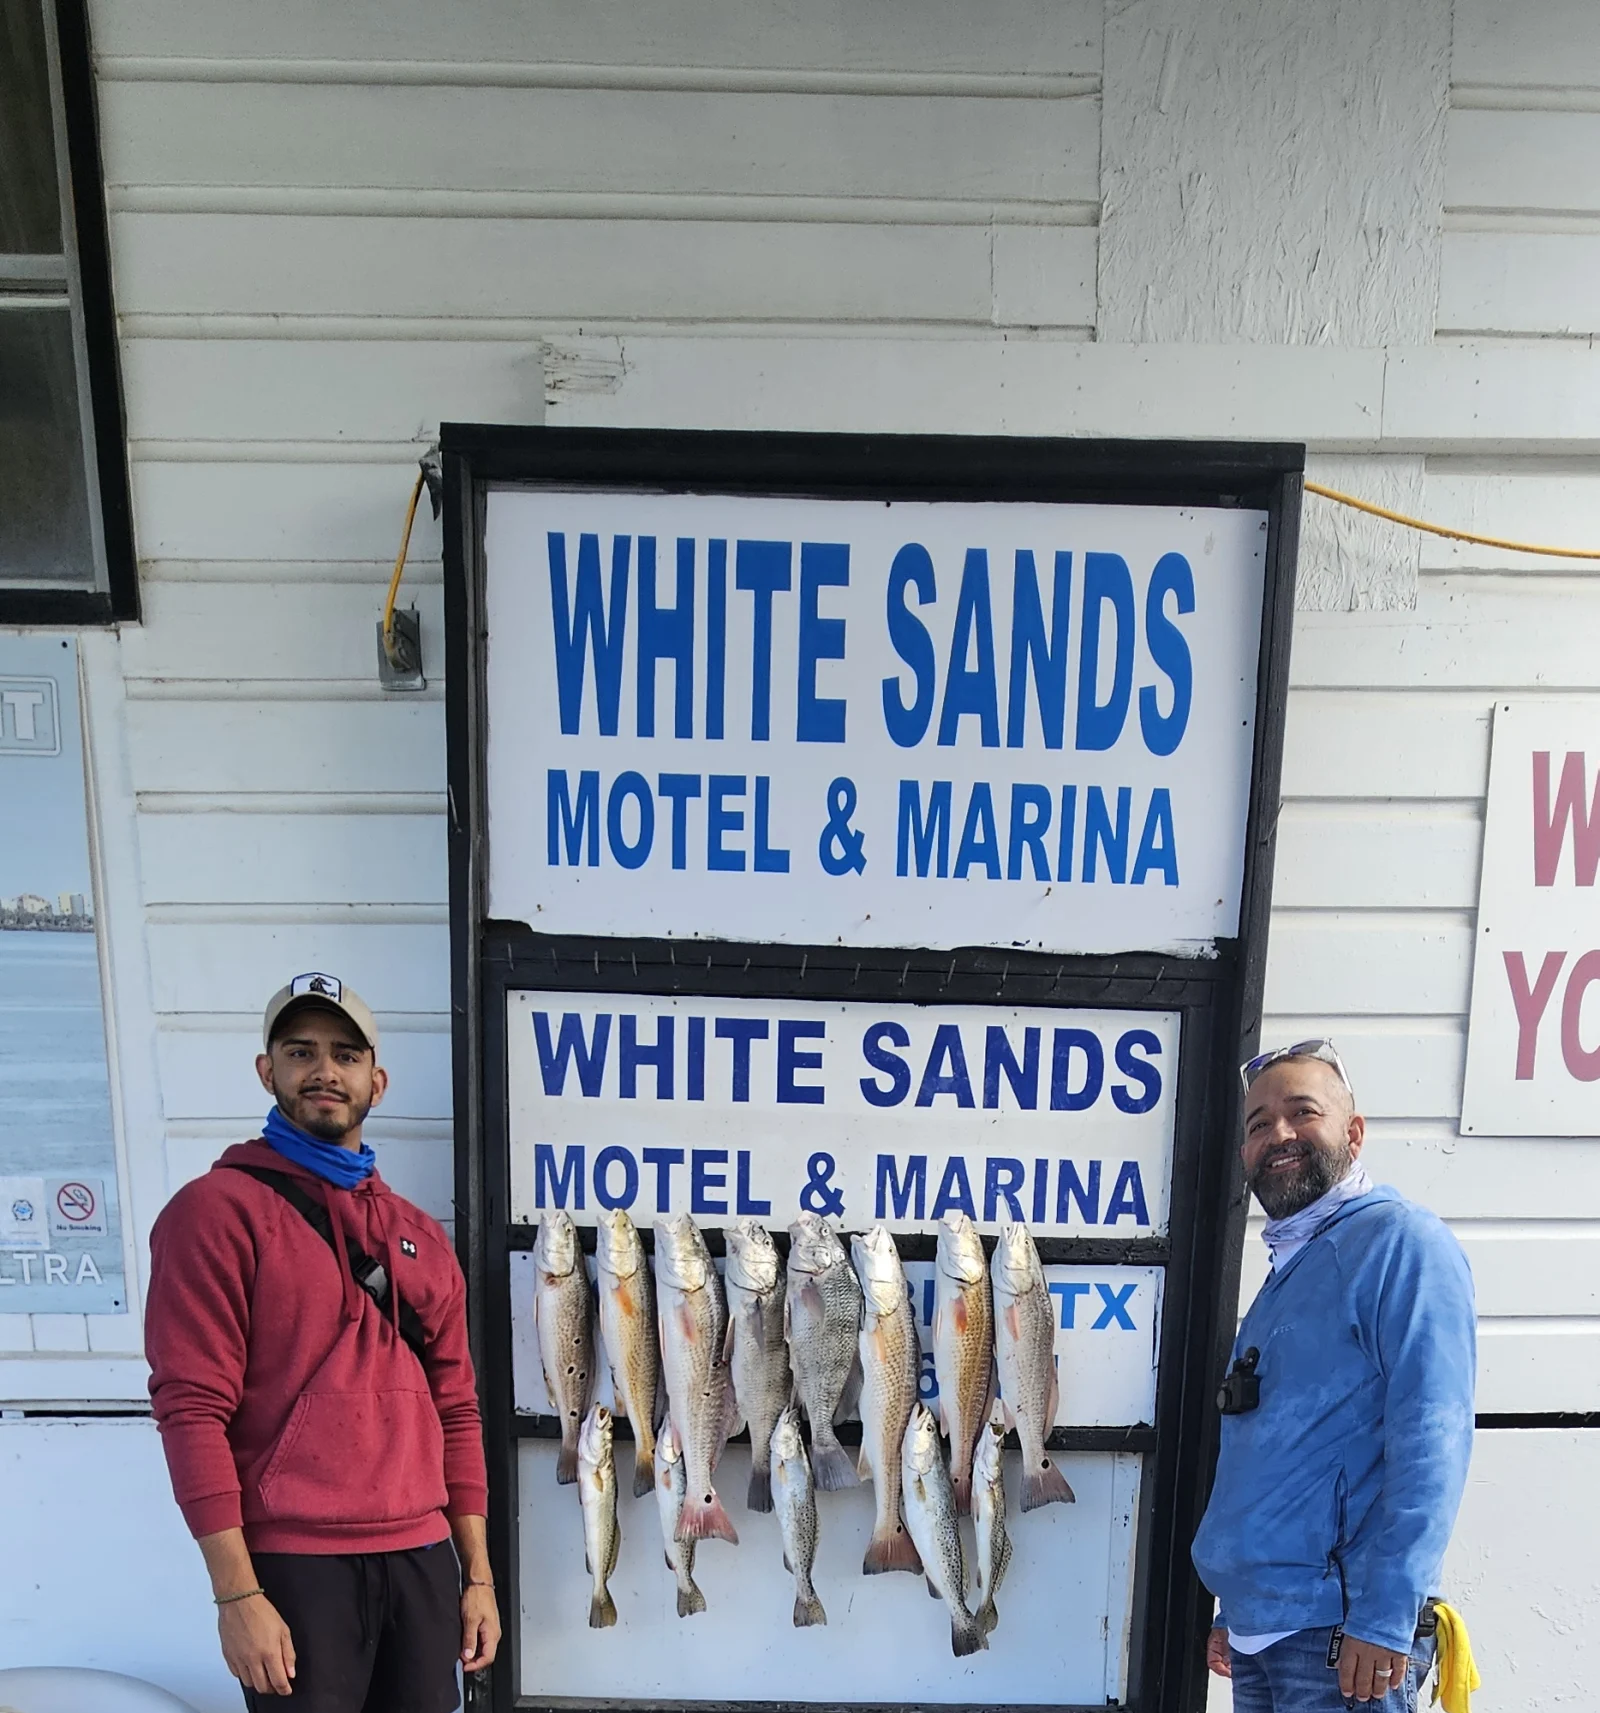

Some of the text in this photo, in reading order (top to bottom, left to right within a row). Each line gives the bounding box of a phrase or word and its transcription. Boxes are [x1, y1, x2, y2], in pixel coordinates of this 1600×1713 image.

[547, 531, 1197, 758] WHITE SANDS
[0, 690, 45, 741] T
[547, 769, 1180, 888] MOTEL & MARINA
[532, 1011, 1162, 1114] WHITE SANDS
[534, 1143, 1150, 1227] MOTEL & MARINA
[68, 1224, 102, 1232] Smoking
[1048, 1282, 1139, 1332] TX
